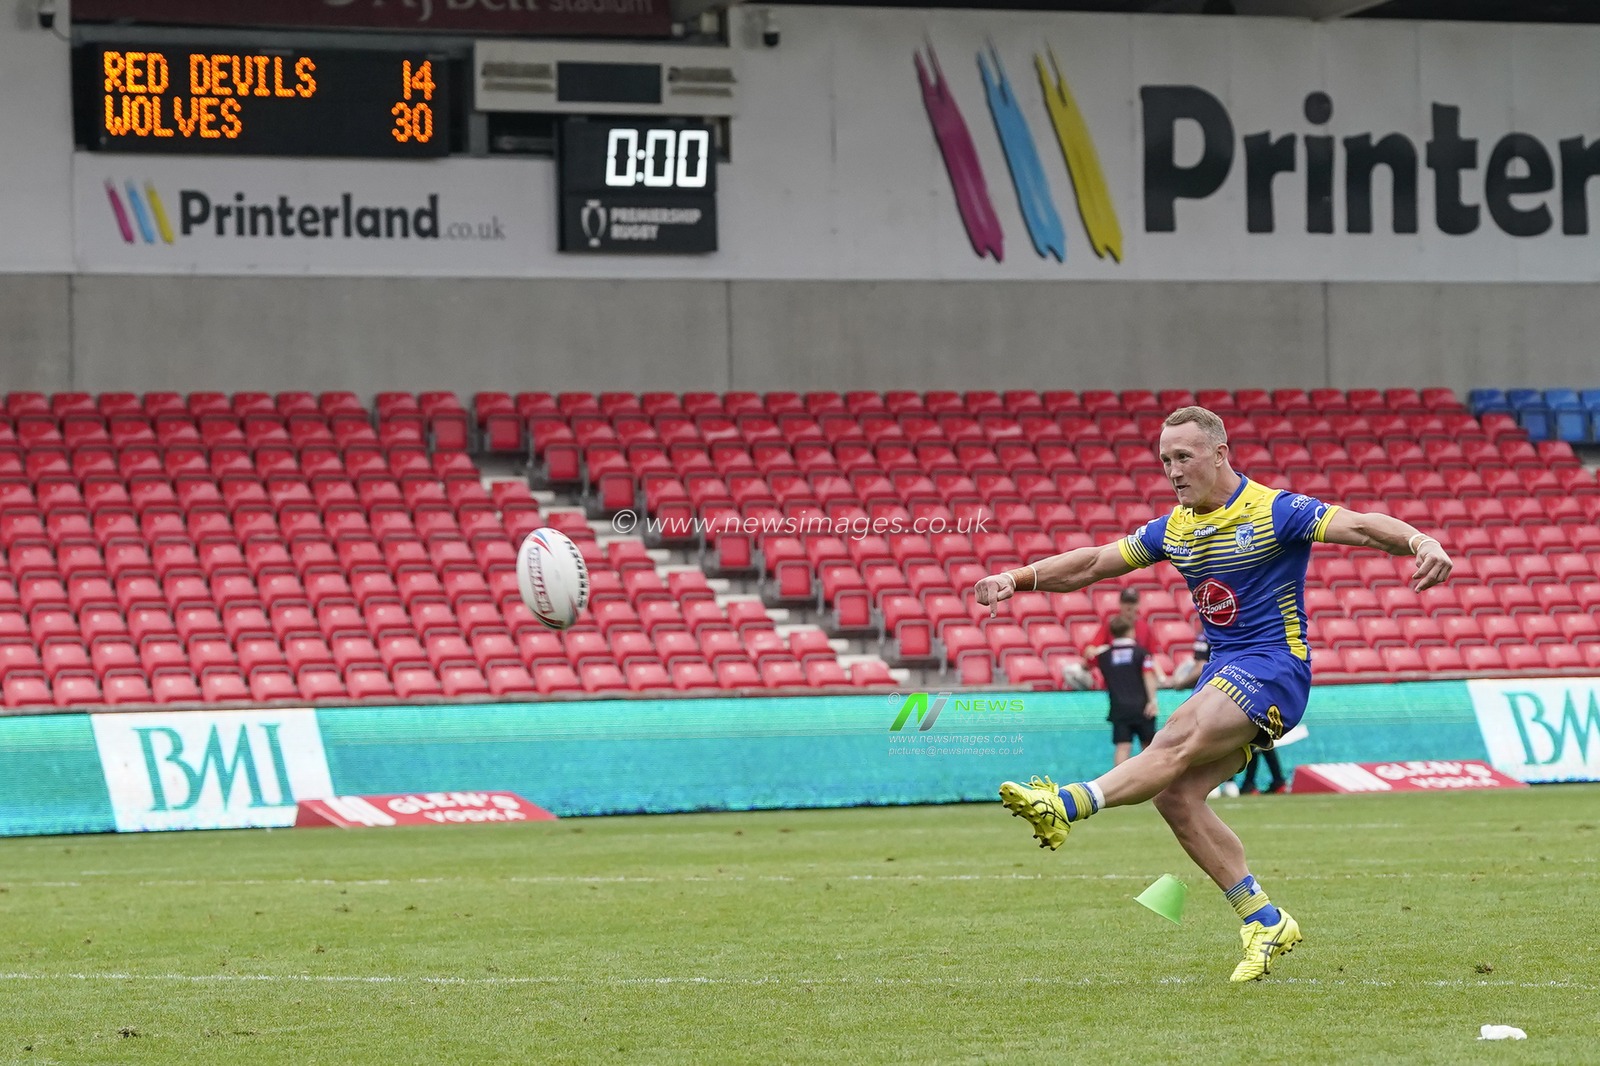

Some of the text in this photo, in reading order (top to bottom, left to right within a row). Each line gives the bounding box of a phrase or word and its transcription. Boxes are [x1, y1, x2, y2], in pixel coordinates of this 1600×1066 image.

[103, 51, 437, 101] RED DEVILS 14
[104, 94, 434, 143] WOLVES 30
[605, 128, 709, 188] 0:00
[132, 722, 297, 812] BMI
[423, 808, 527, 823] VODKA
